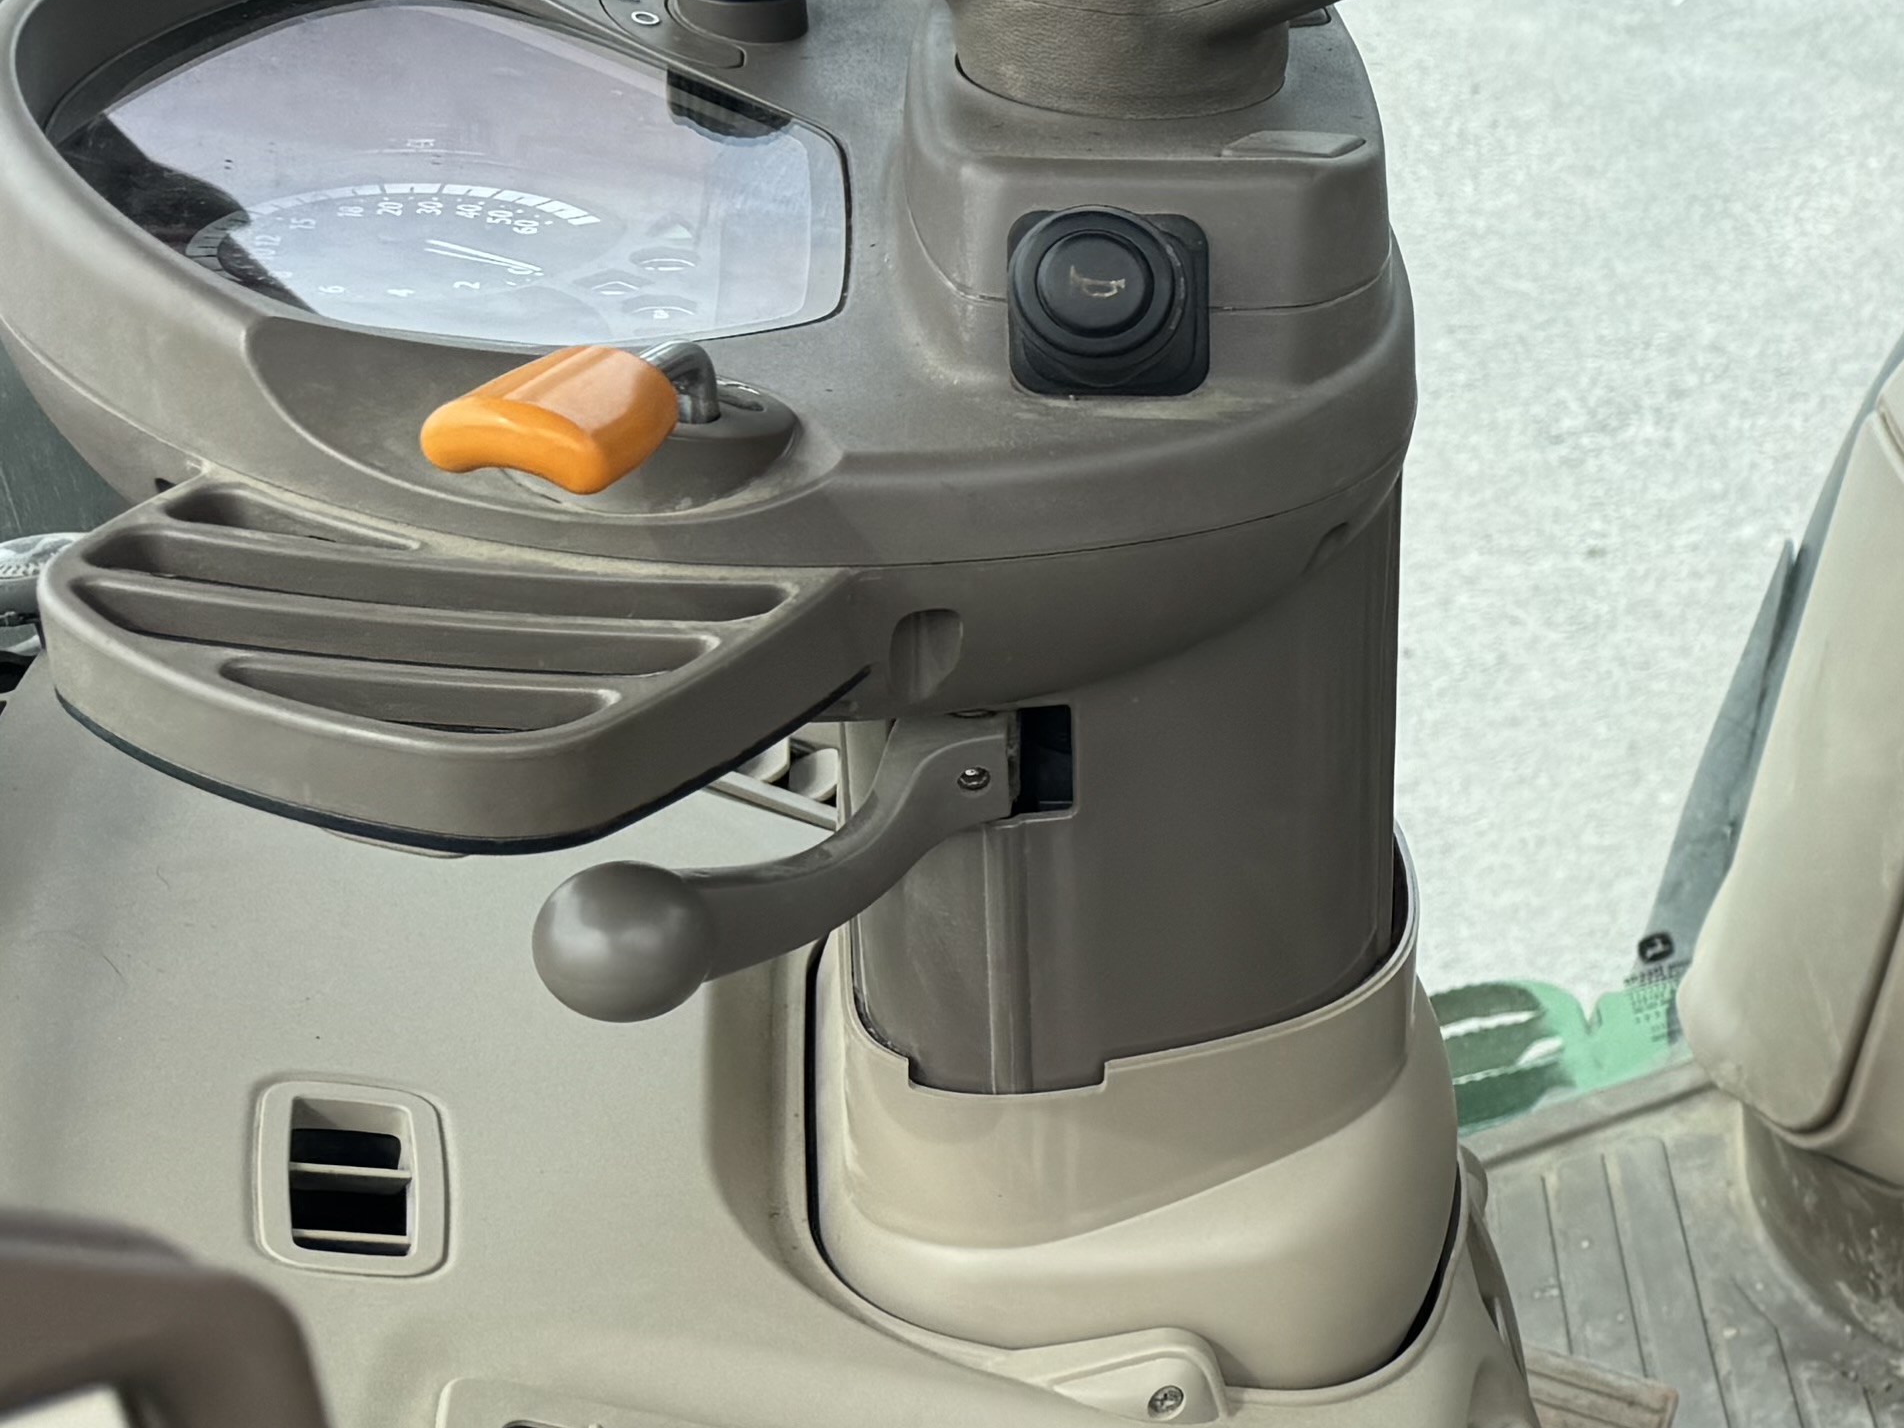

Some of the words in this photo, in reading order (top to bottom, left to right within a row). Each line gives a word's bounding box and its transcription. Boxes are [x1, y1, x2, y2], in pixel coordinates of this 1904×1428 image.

[377, 201, 404, 217] 20
[416, 200, 444, 216] 30
[455, 203, 483, 219] 40
[486, 209, 514, 225] 50
[512, 219, 540, 235] 60
[453, 280, 480, 290] 2
